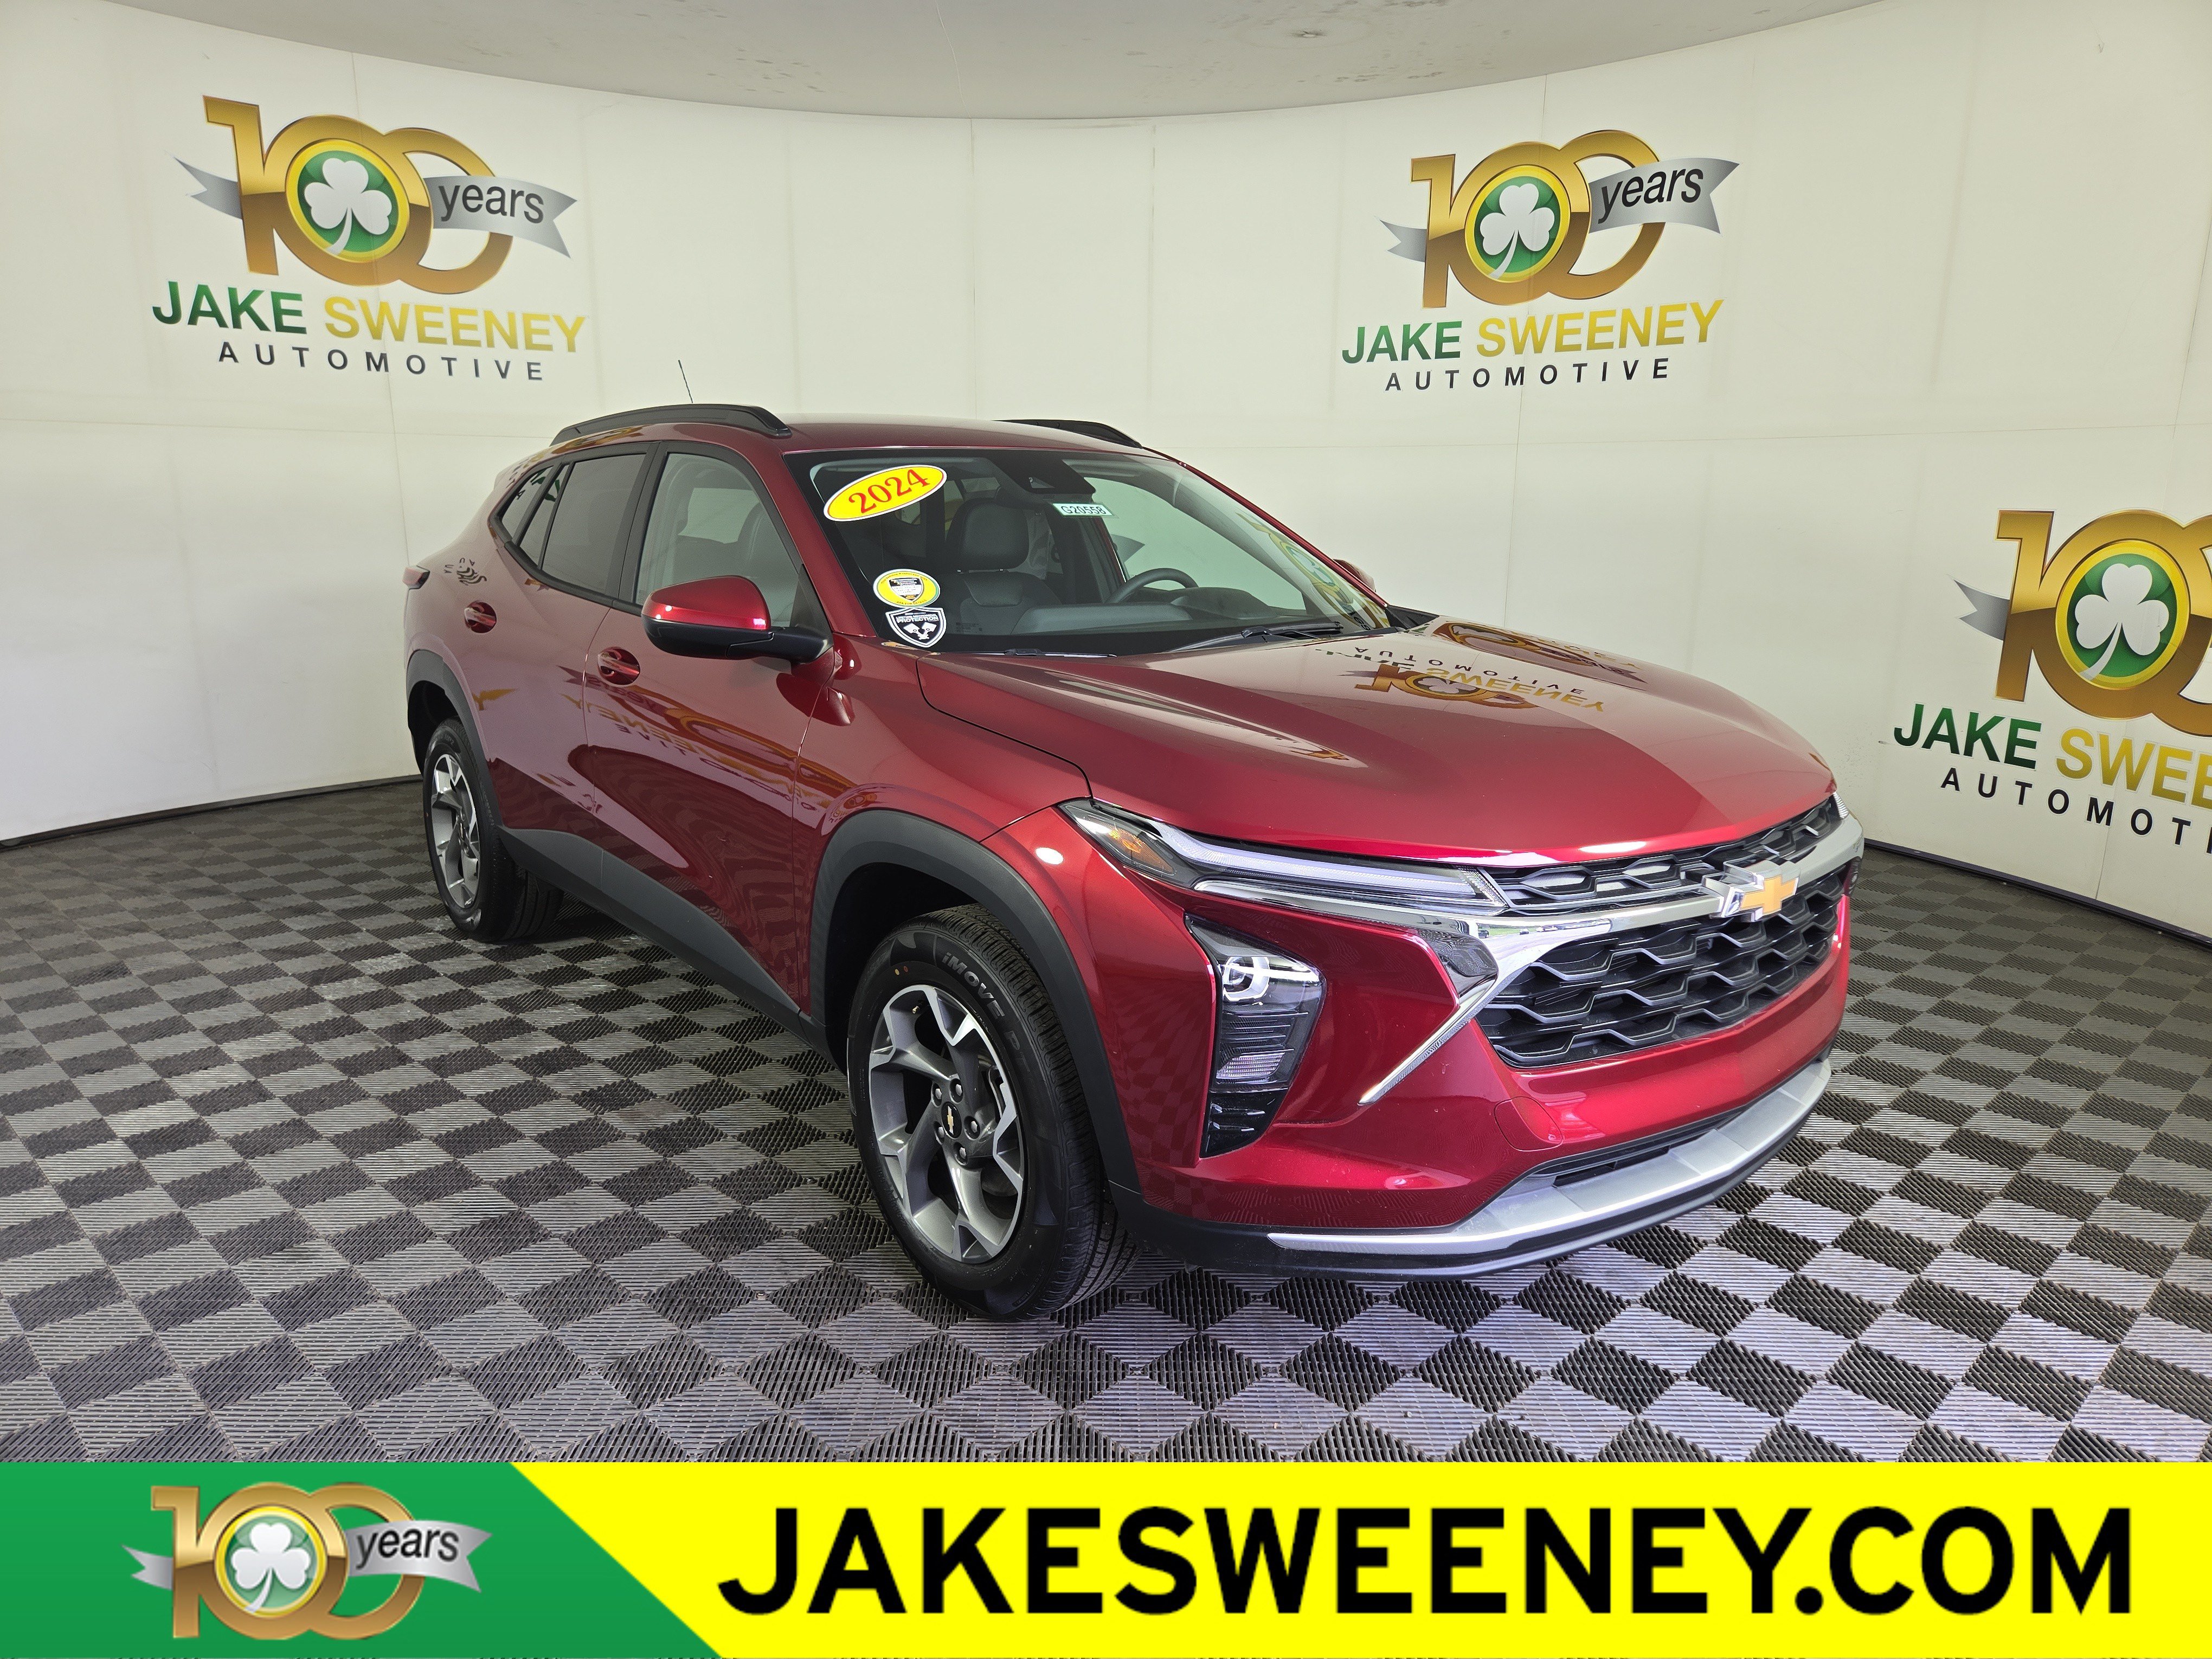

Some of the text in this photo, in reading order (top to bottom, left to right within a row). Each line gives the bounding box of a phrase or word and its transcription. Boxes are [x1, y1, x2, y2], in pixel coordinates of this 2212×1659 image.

[439, 184, 544, 224] years
[1598, 167, 1704, 224] years
[152, 280, 586, 353] JAKE SWEENEY
[1342, 299, 1725, 364] JAKE SWEENEY
[218, 341, 543, 381] AUTOMOTIVE
[1385, 358, 1669, 391] AUTOMOTIVE
[849, 469, 930, 513] 2024
[1061, 506, 1106, 515] G20558
[1894, 703, 2042, 770] JAKE
[942, 952, 1005, 1019] iMOVE
